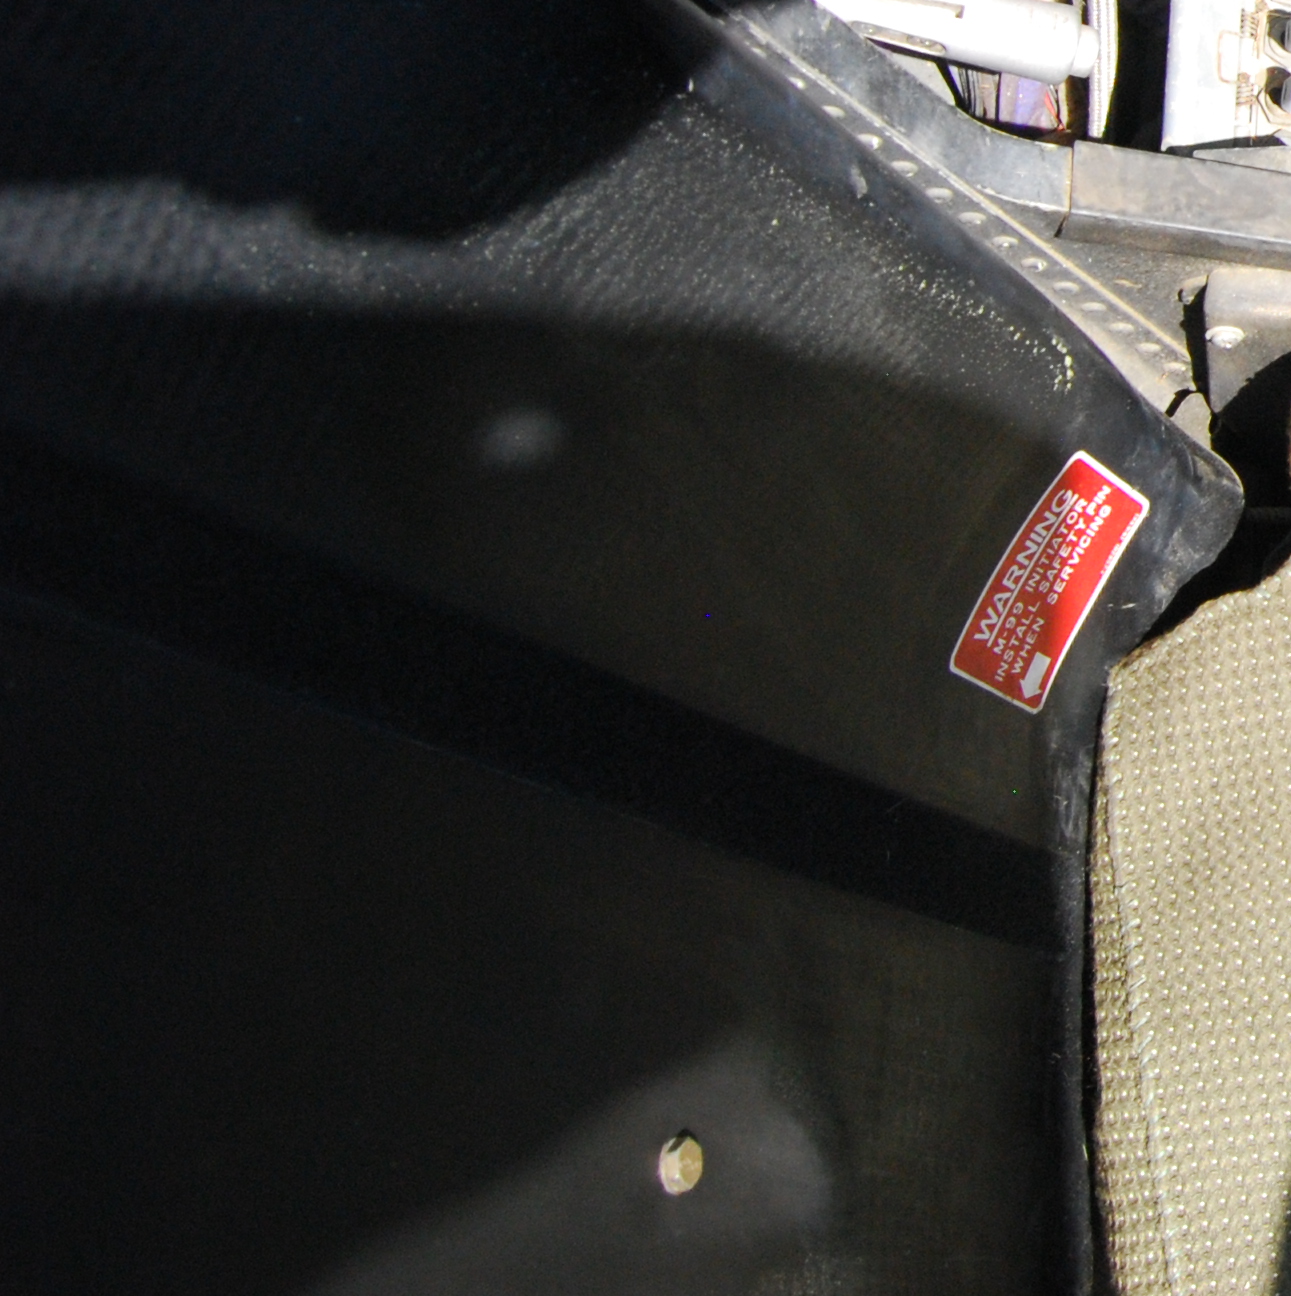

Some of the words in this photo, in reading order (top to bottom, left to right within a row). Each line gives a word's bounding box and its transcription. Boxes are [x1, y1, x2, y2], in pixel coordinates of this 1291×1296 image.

[974, 488, 1076, 642] WARNING
[994, 601, 1024, 655] M-99
[1025, 499, 1088, 593] INITIATOR
[995, 601, 1040, 682] INSTALL
[1039, 518, 1087, 594] SAFETY
[1085, 484, 1112, 516] PIN
[1012, 618, 1045, 674] WHEN
[1046, 505, 1112, 606] SERVICING
